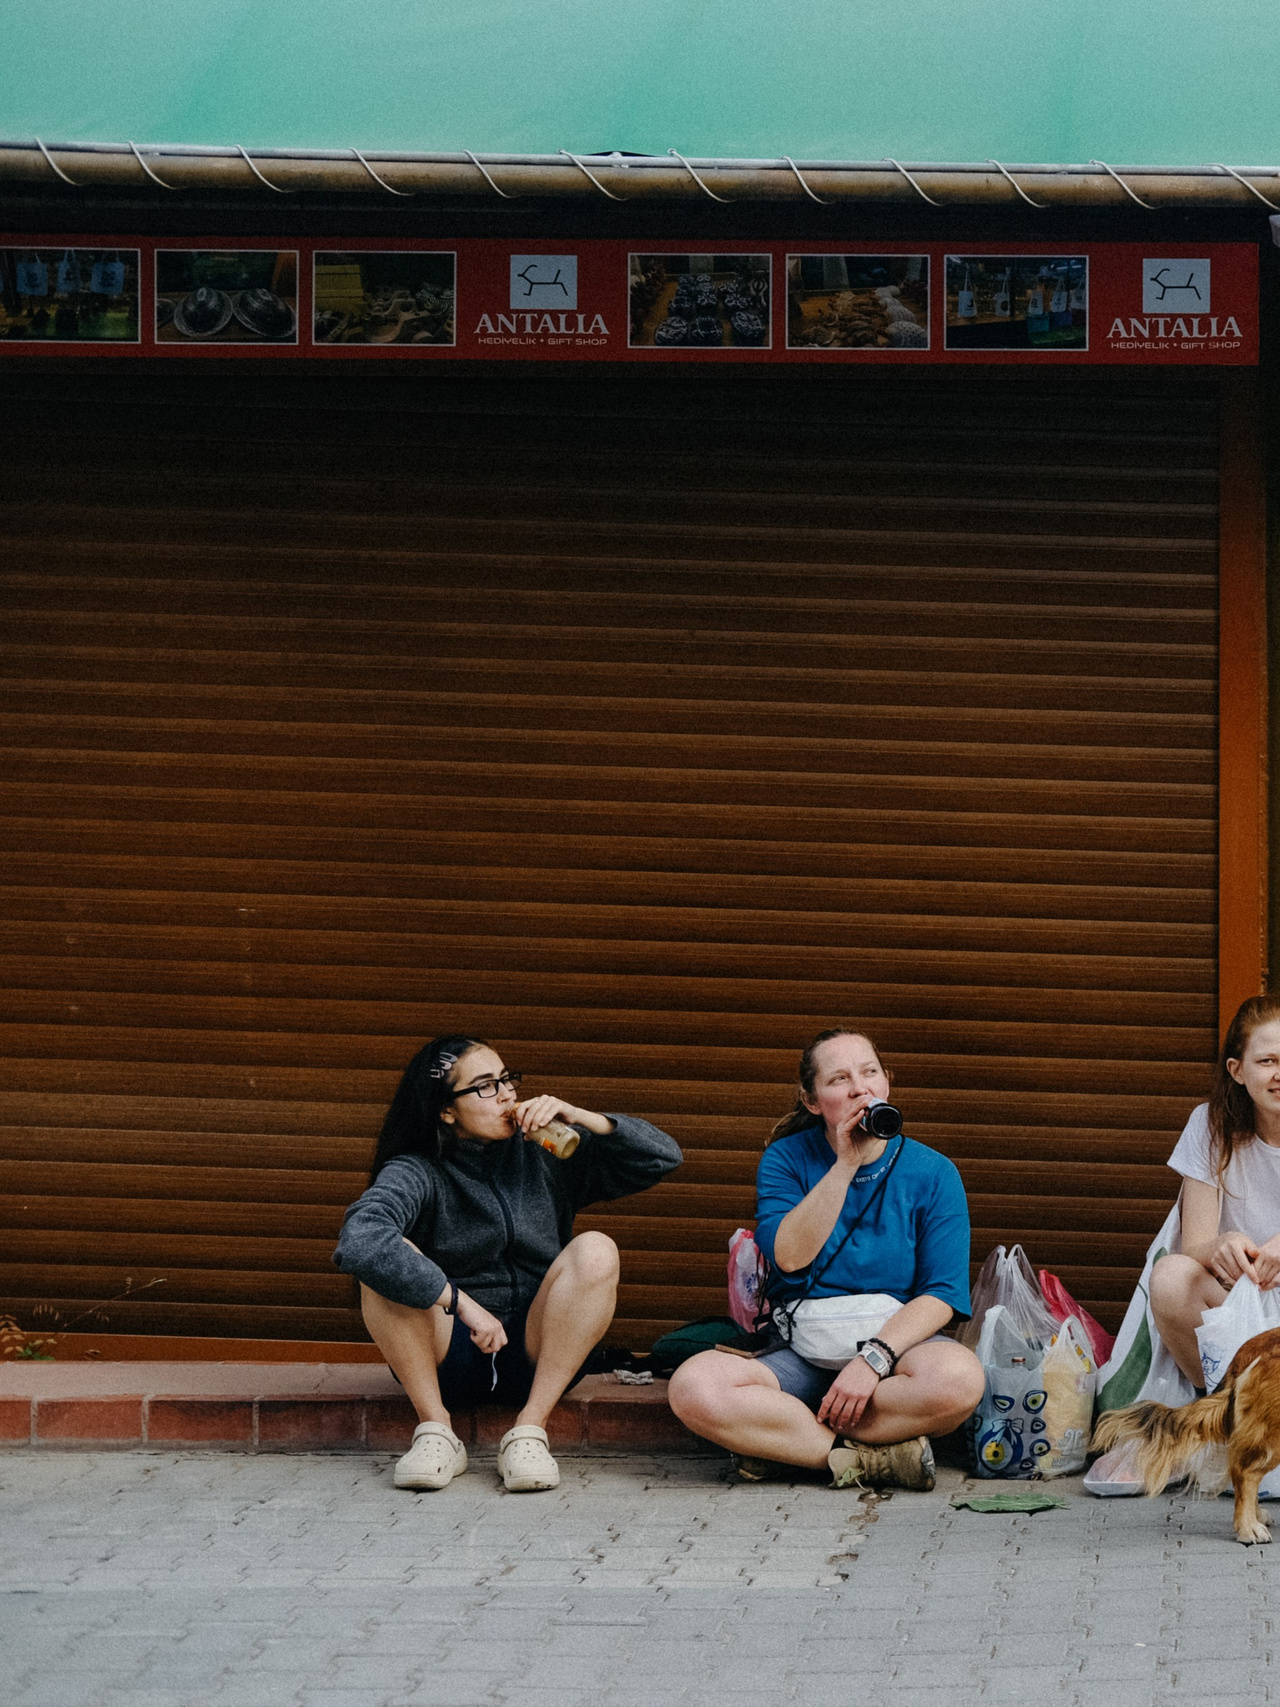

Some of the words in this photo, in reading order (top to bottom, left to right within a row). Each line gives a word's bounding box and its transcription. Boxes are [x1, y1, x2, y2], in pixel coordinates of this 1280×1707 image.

[474, 313, 610, 335] ANTALIA
[1106, 316, 1243, 339] ANTALIA
[547, 338, 572, 346] GIFT
[575, 338, 608, 346] SHOP
[1181, 342, 1205, 350] GIFT
[1208, 341, 1241, 349] SHOP
